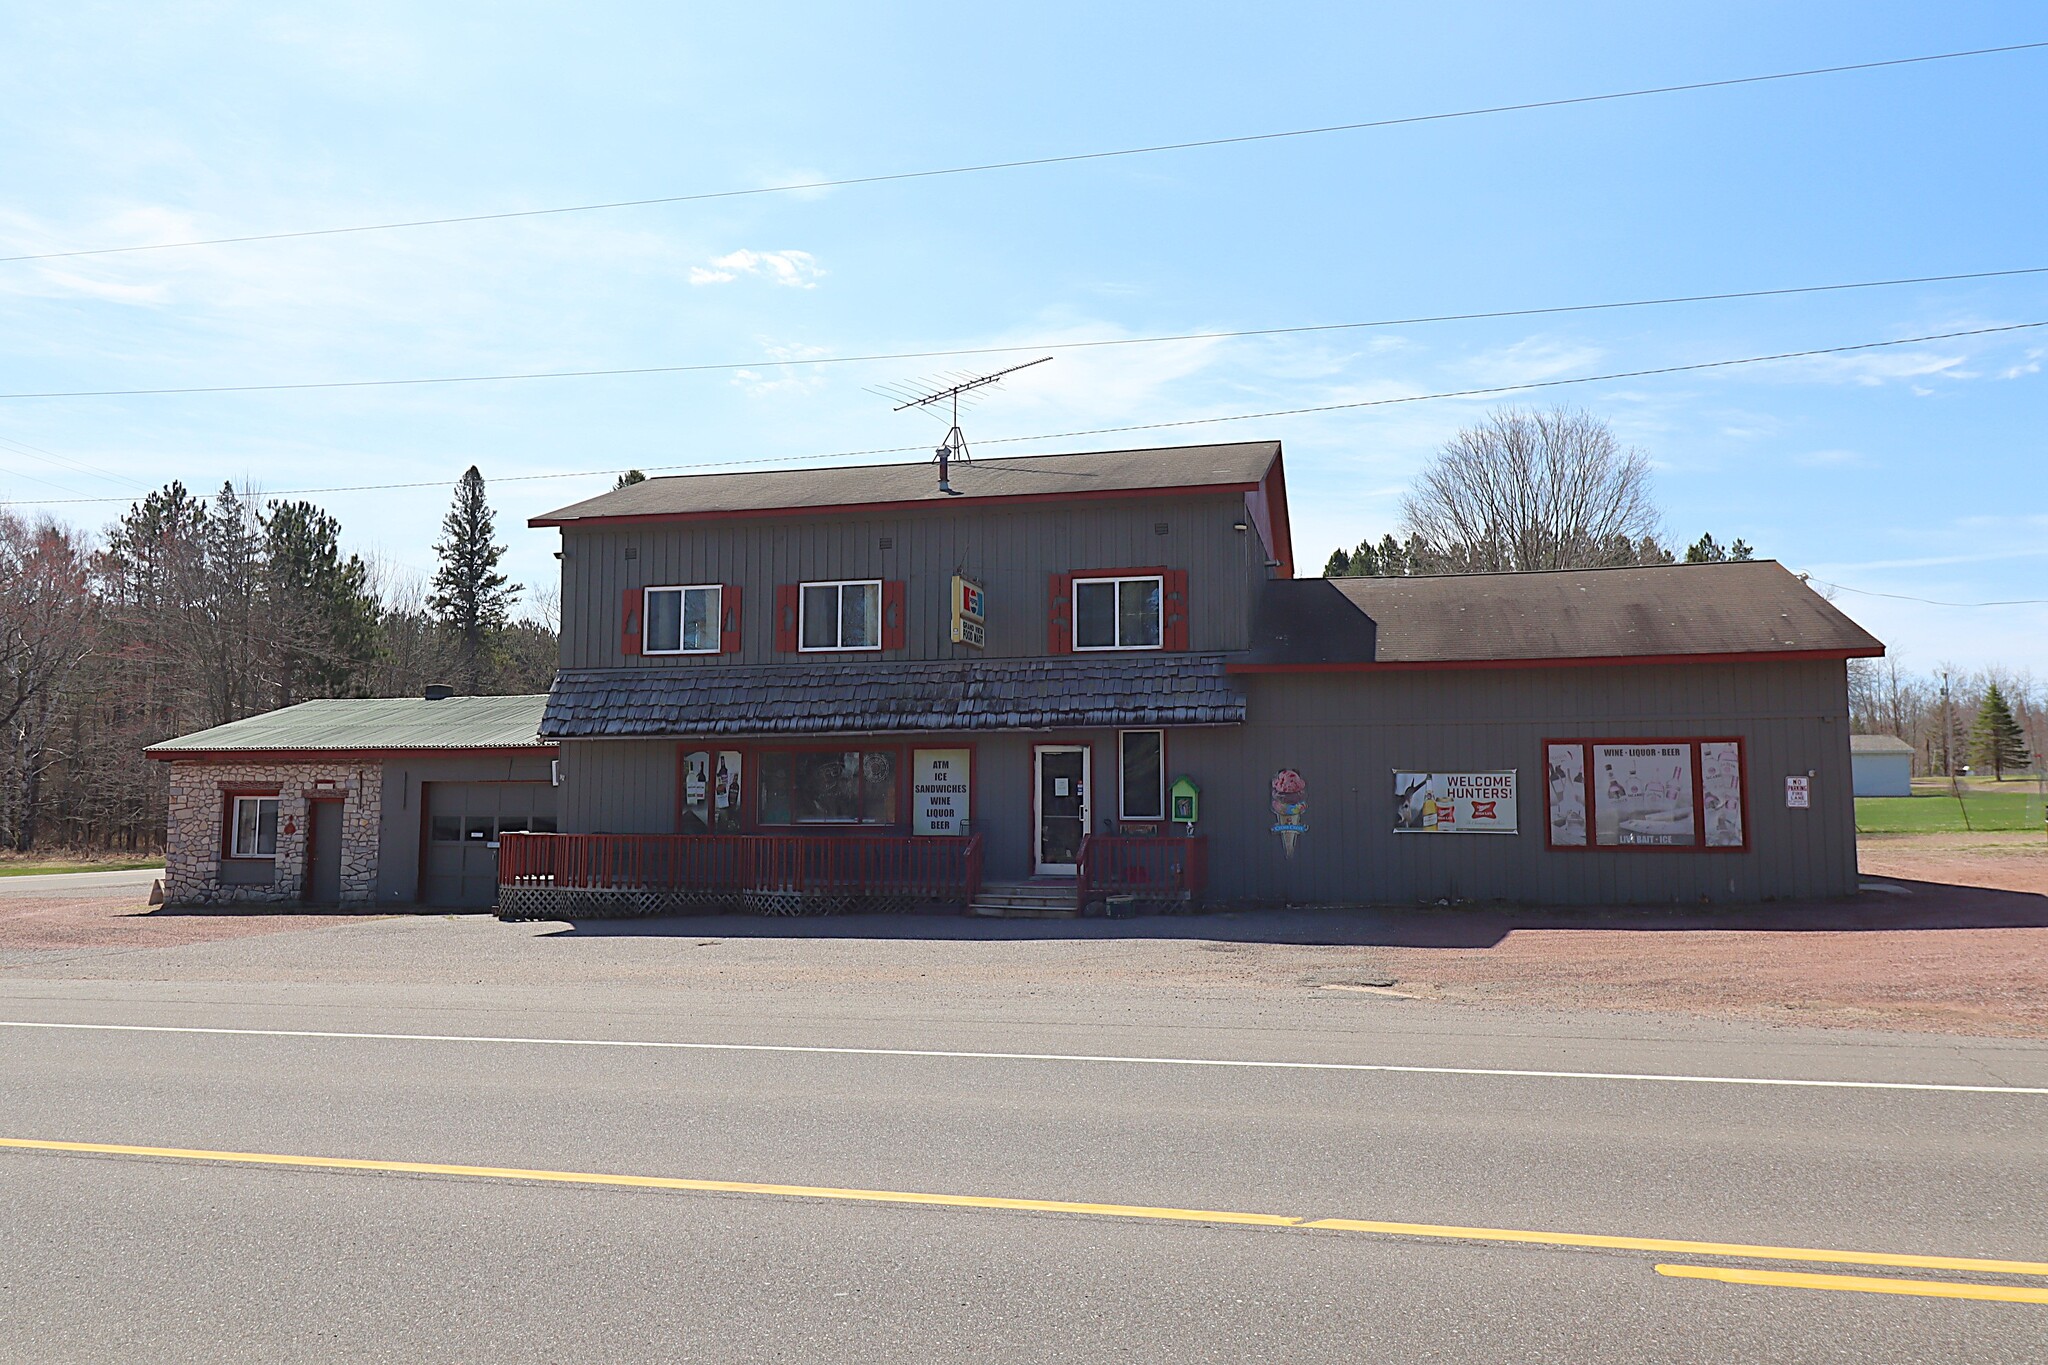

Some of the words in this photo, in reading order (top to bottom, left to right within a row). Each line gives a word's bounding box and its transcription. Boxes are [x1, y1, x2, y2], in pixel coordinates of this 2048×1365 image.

[963, 629, 973, 641] FOOD
[1604, 749, 1623, 757] WINE
[1629, 749, 1656, 757] LIQUOR
[1662, 748, 1680, 756] BEER
[933, 761, 949, 769] ATM
[935, 773, 947, 781] ICE
[1447, 776, 1512, 787] WELCOME
[915, 785, 967, 793] SANDWICHES
[1447, 788, 1512, 799] HUNTERS!
[930, 797, 951, 805] WINE
[926, 809, 955, 818] LIQUOR
[931, 821, 950, 829] BEER
[1636, 835, 1654, 843] BAIT
[1660, 835, 1672, 843] ICE
